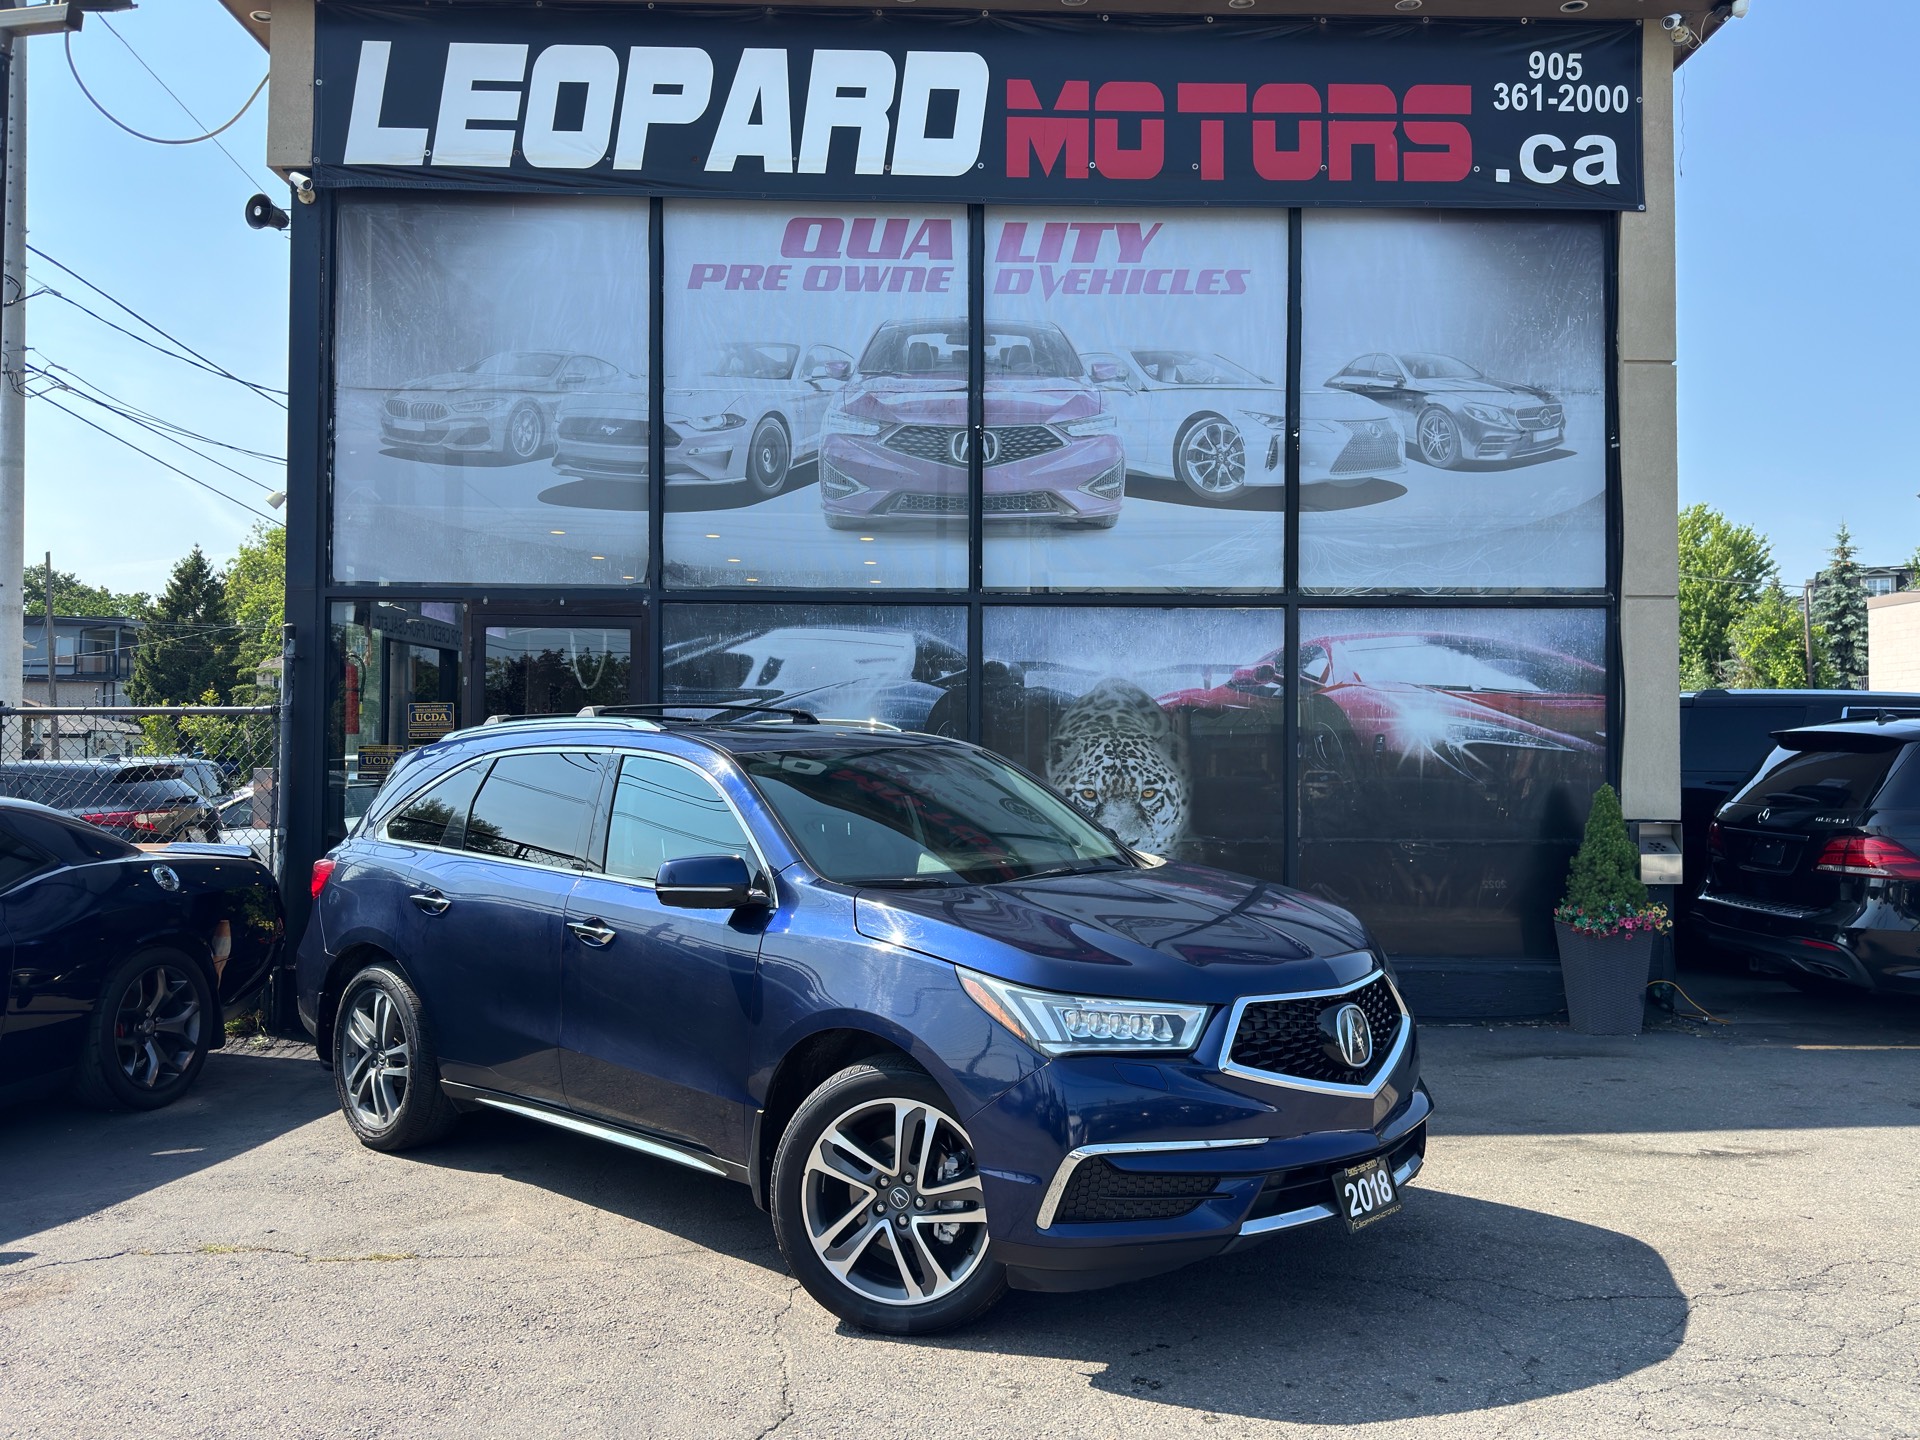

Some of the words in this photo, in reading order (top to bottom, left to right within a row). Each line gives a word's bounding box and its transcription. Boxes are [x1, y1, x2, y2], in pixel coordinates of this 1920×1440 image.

[1528, 51, 1583, 81] 905
[343, 40, 989, 177] LEOPARD
[1006, 79, 1472, 182] MOTORS
[1493, 82, 1629, 113] 361-2000
[1495, 133, 1621, 185] .ca
[687, 263, 792, 291] PRE
[415, 713, 447, 721] UCDA
[365, 756, 395, 765] UCDA
[1344, 1169, 1393, 1218] 2018
